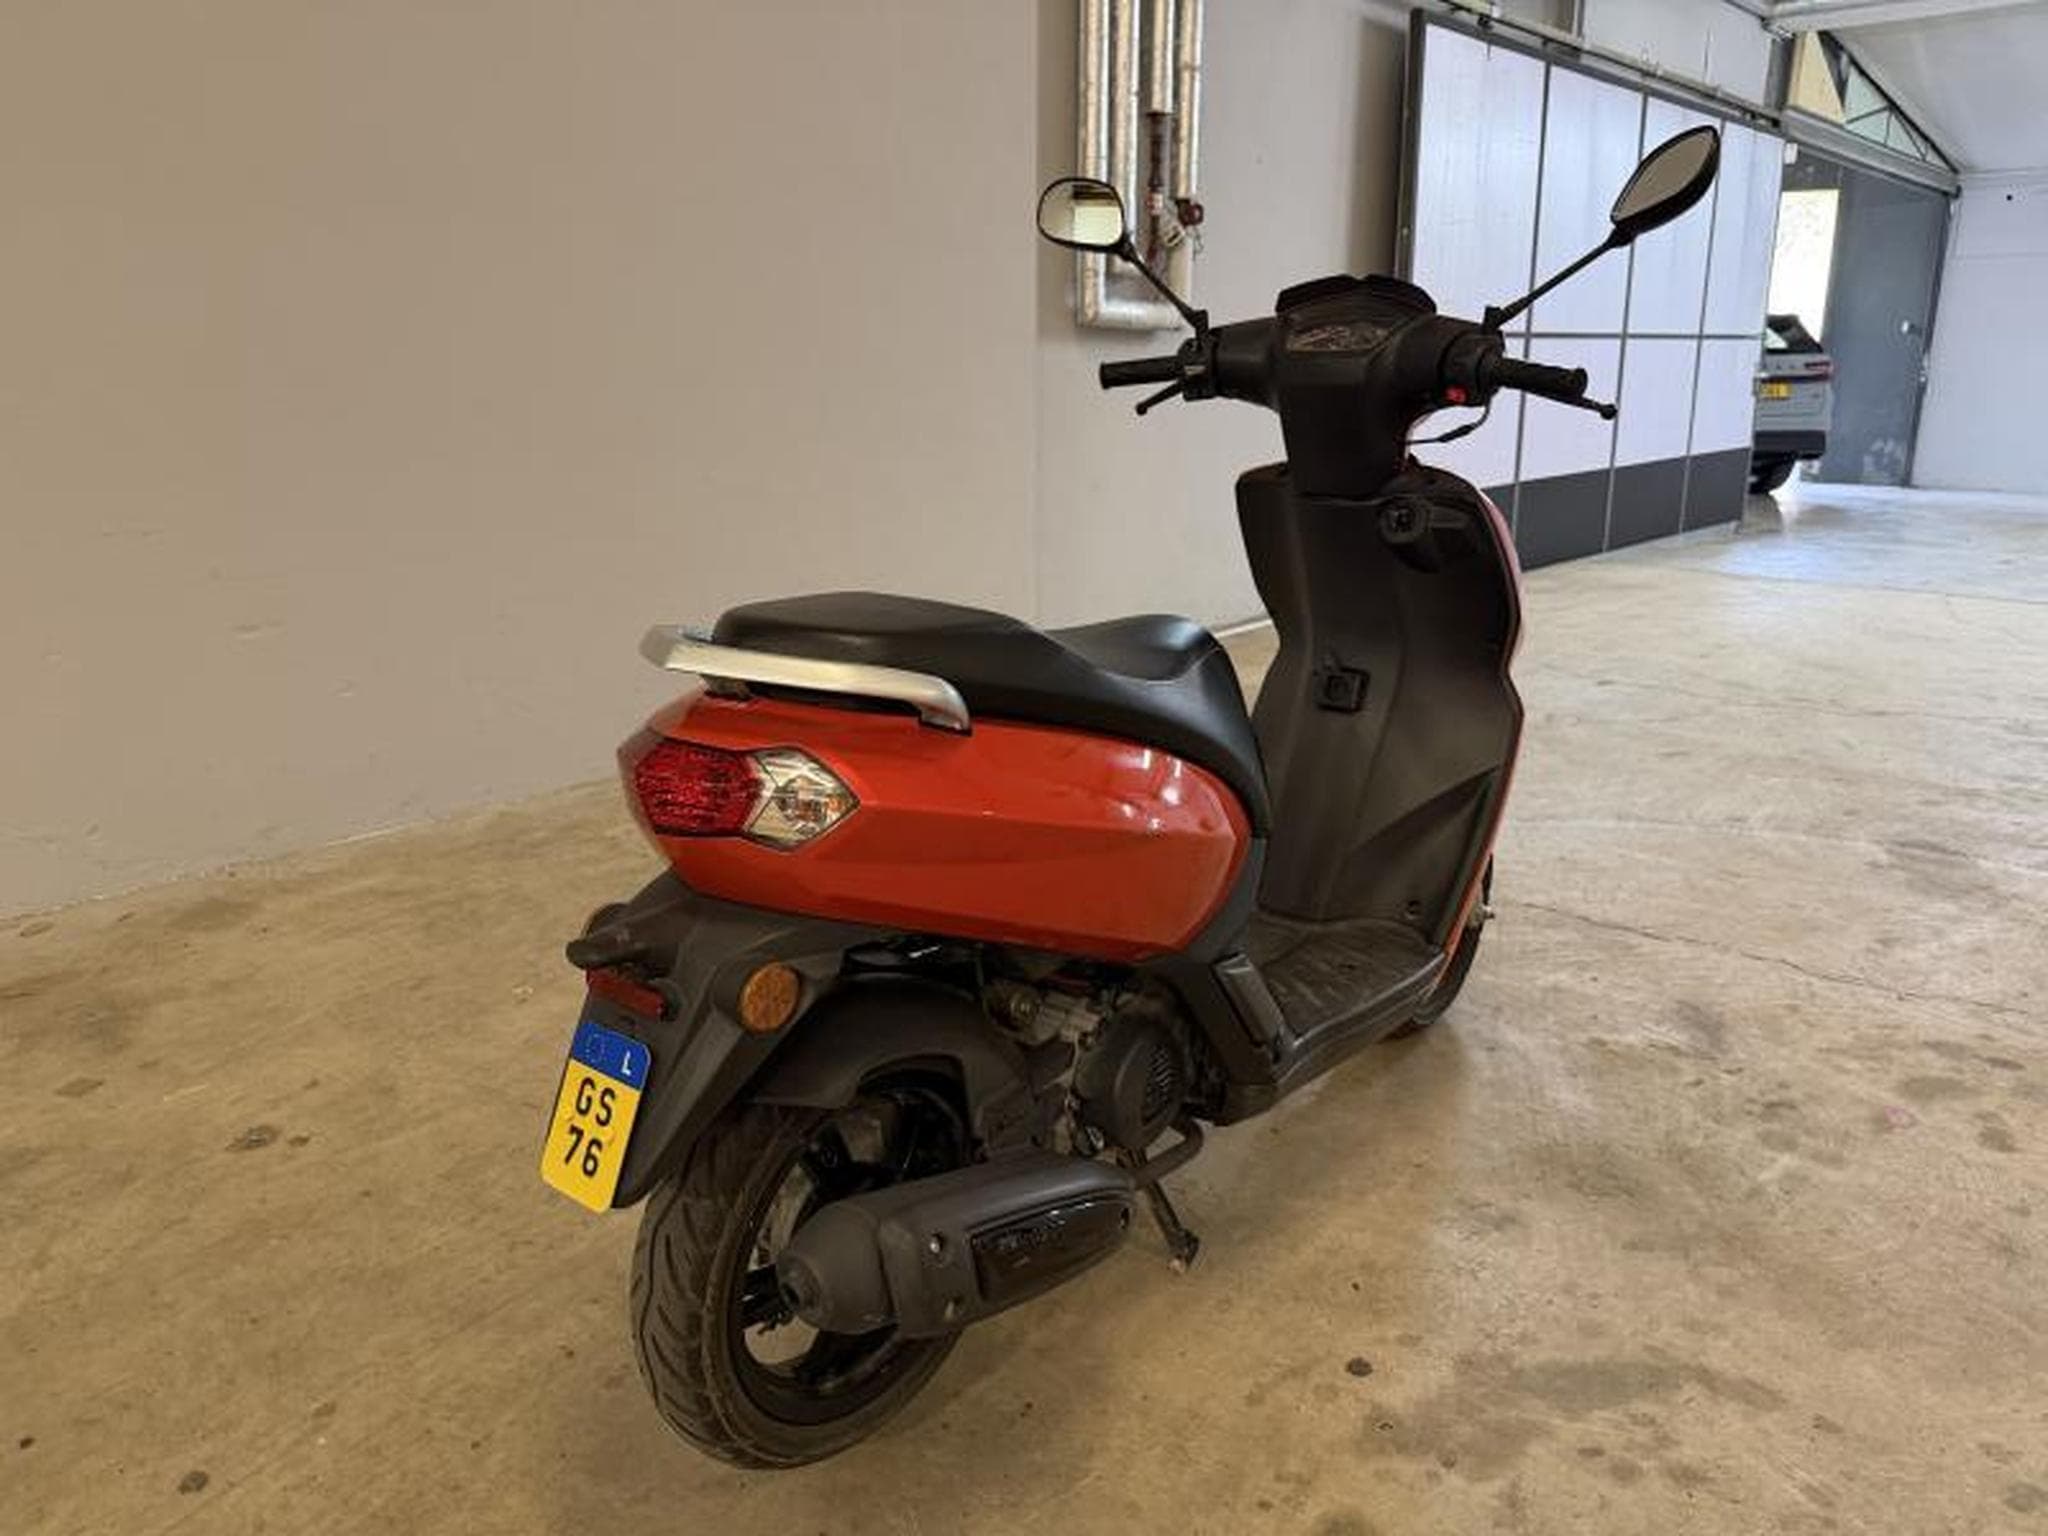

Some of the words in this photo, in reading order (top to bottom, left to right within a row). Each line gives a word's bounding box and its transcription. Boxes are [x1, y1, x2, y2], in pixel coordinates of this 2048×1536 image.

[621, 1050, 632, 1077] L
[576, 1077, 616, 1127] GS
[564, 1125, 603, 1177] 76
